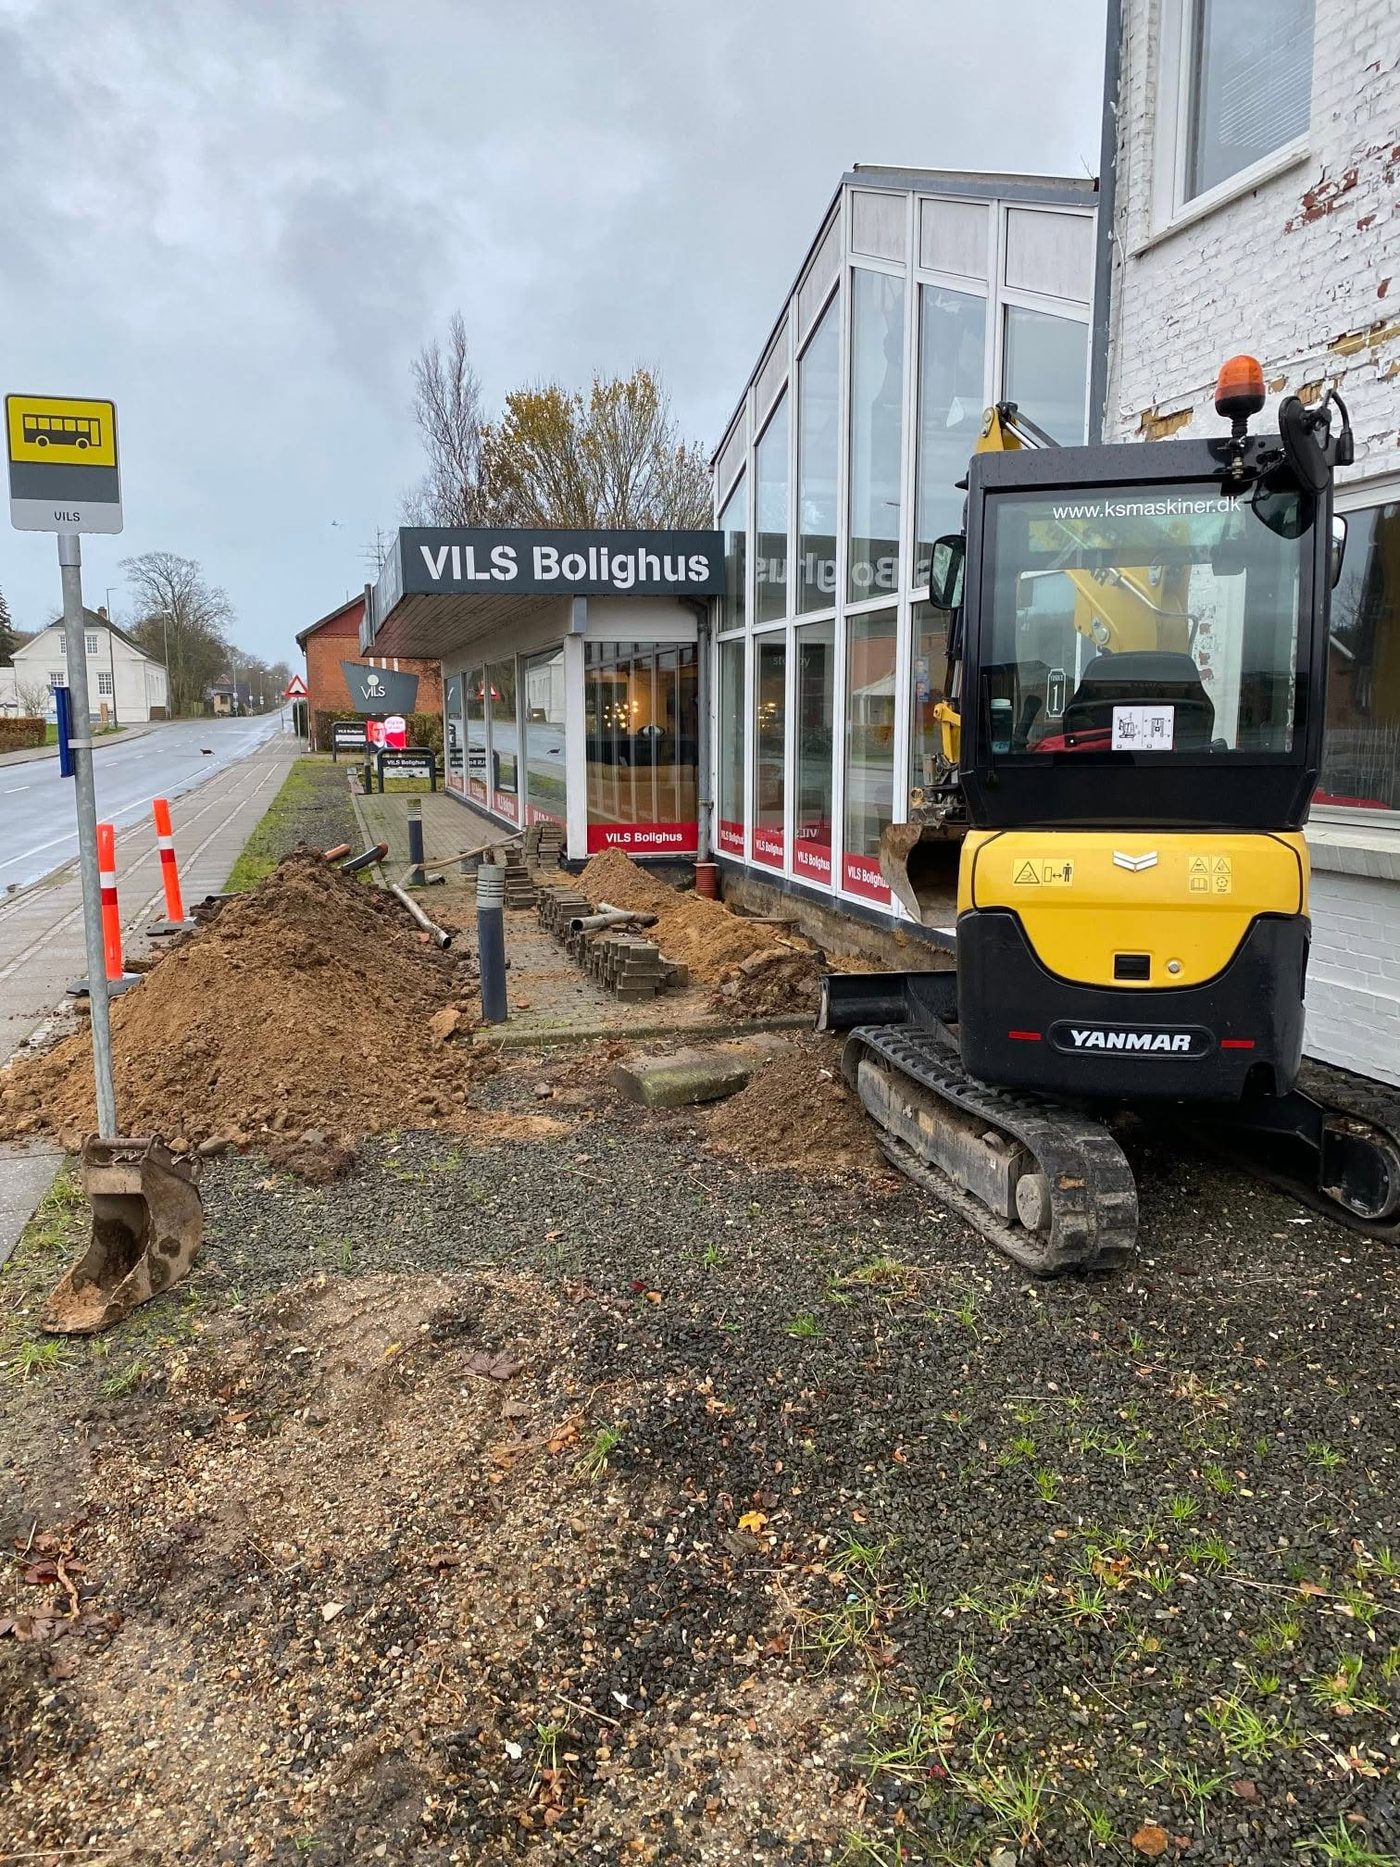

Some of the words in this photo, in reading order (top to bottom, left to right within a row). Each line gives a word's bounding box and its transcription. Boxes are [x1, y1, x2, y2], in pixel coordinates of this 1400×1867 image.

[54, 511, 80, 522] VILS
[1052, 496, 1241, 519] www.ksmaskiner.dk
[420, 545, 518, 581] VILS
[532, 545, 710, 589] Bolighus
[360, 685, 386, 700] VILS
[605, 833, 632, 843] VILS
[634, 832, 683, 844] Bolighus
[797, 850, 809, 864] VILS
[808, 854, 831, 871] Bolighus
[848, 865, 862, 881] VILS
[1070, 1029, 1192, 1051] YANMAR
